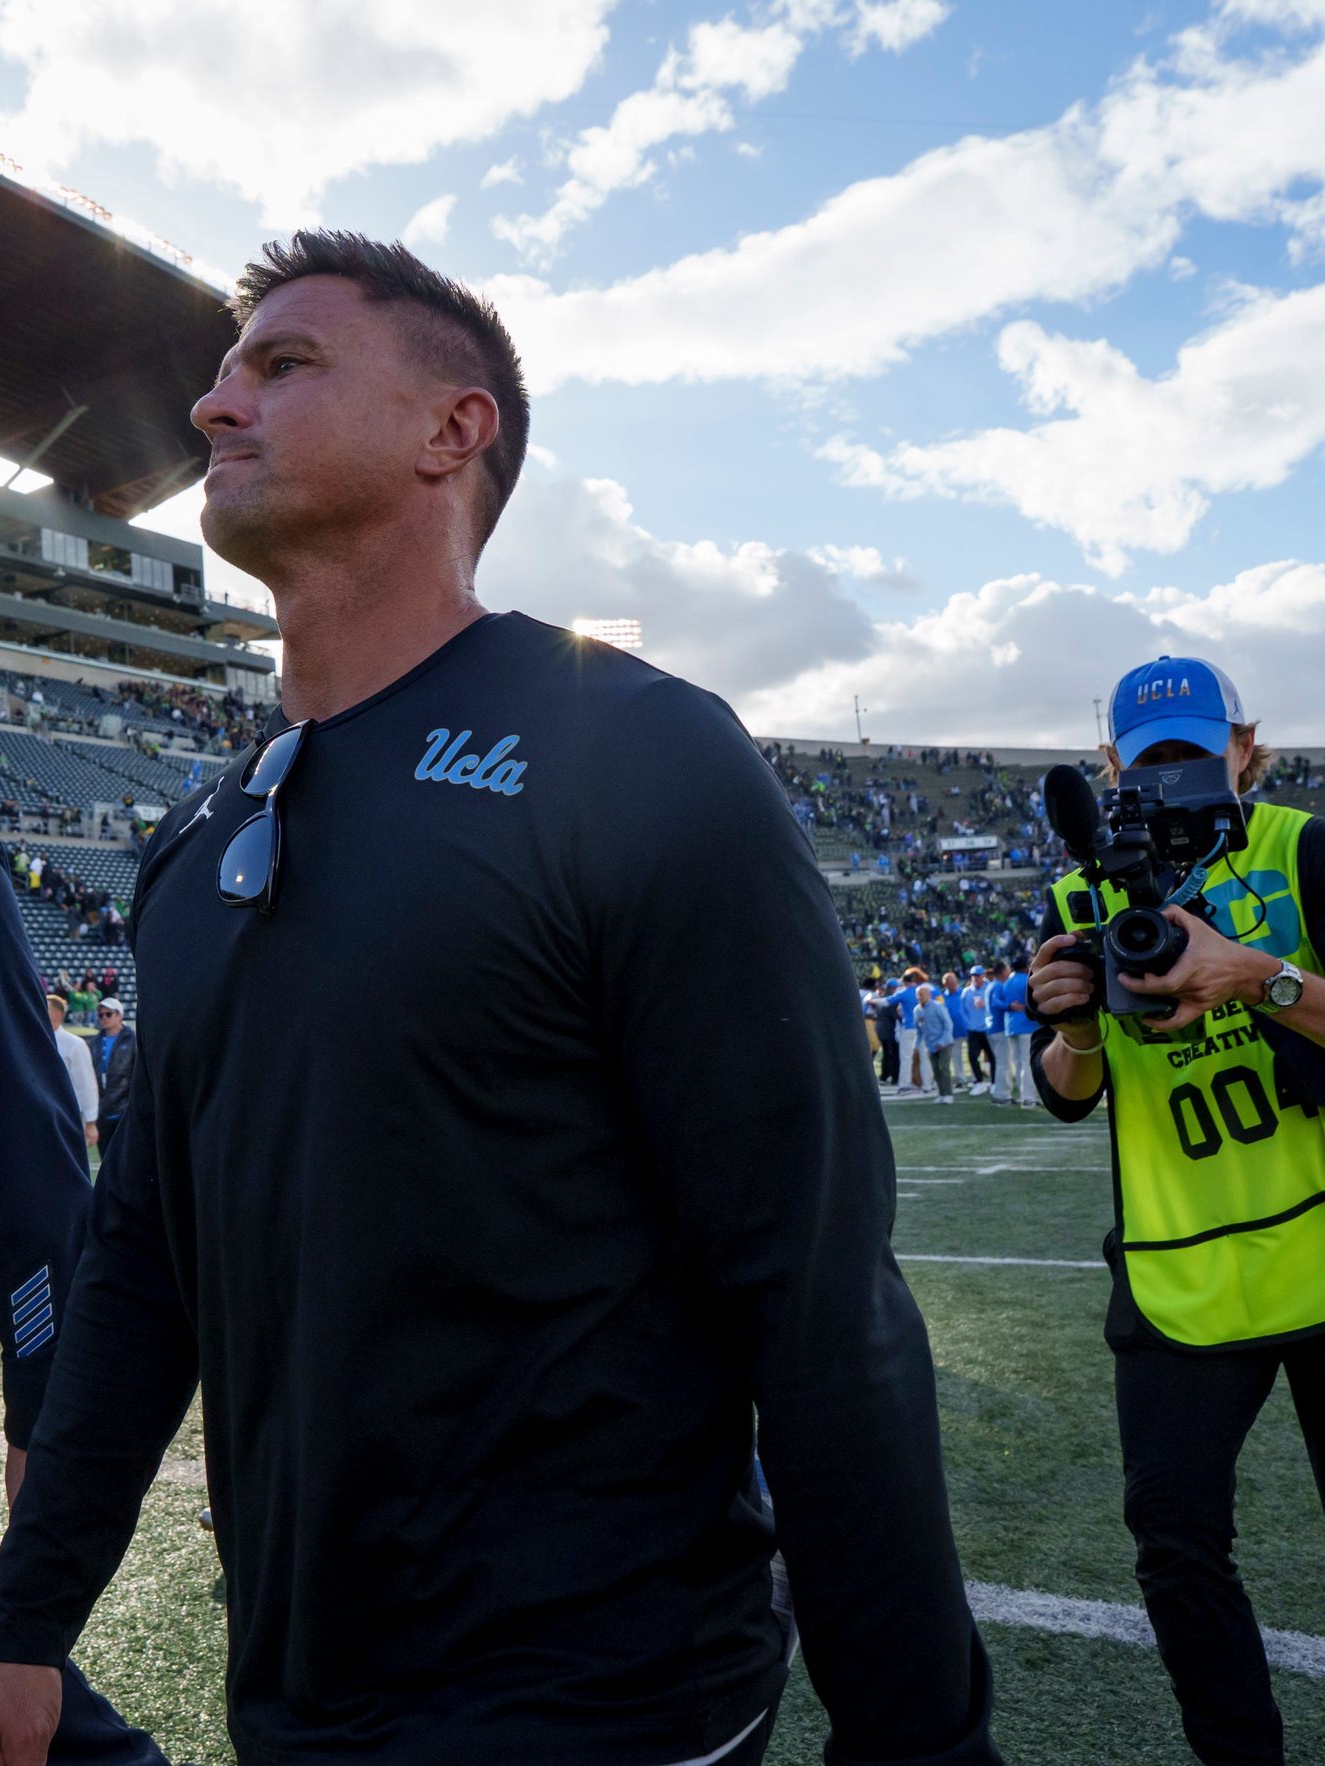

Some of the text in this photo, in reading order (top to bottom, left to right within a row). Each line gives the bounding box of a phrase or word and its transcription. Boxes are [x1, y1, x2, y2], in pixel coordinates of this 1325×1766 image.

[1137, 678, 1191, 704] UCLA
[414, 728, 528, 796] Ucla
[1168, 1065, 1279, 1161] 00
